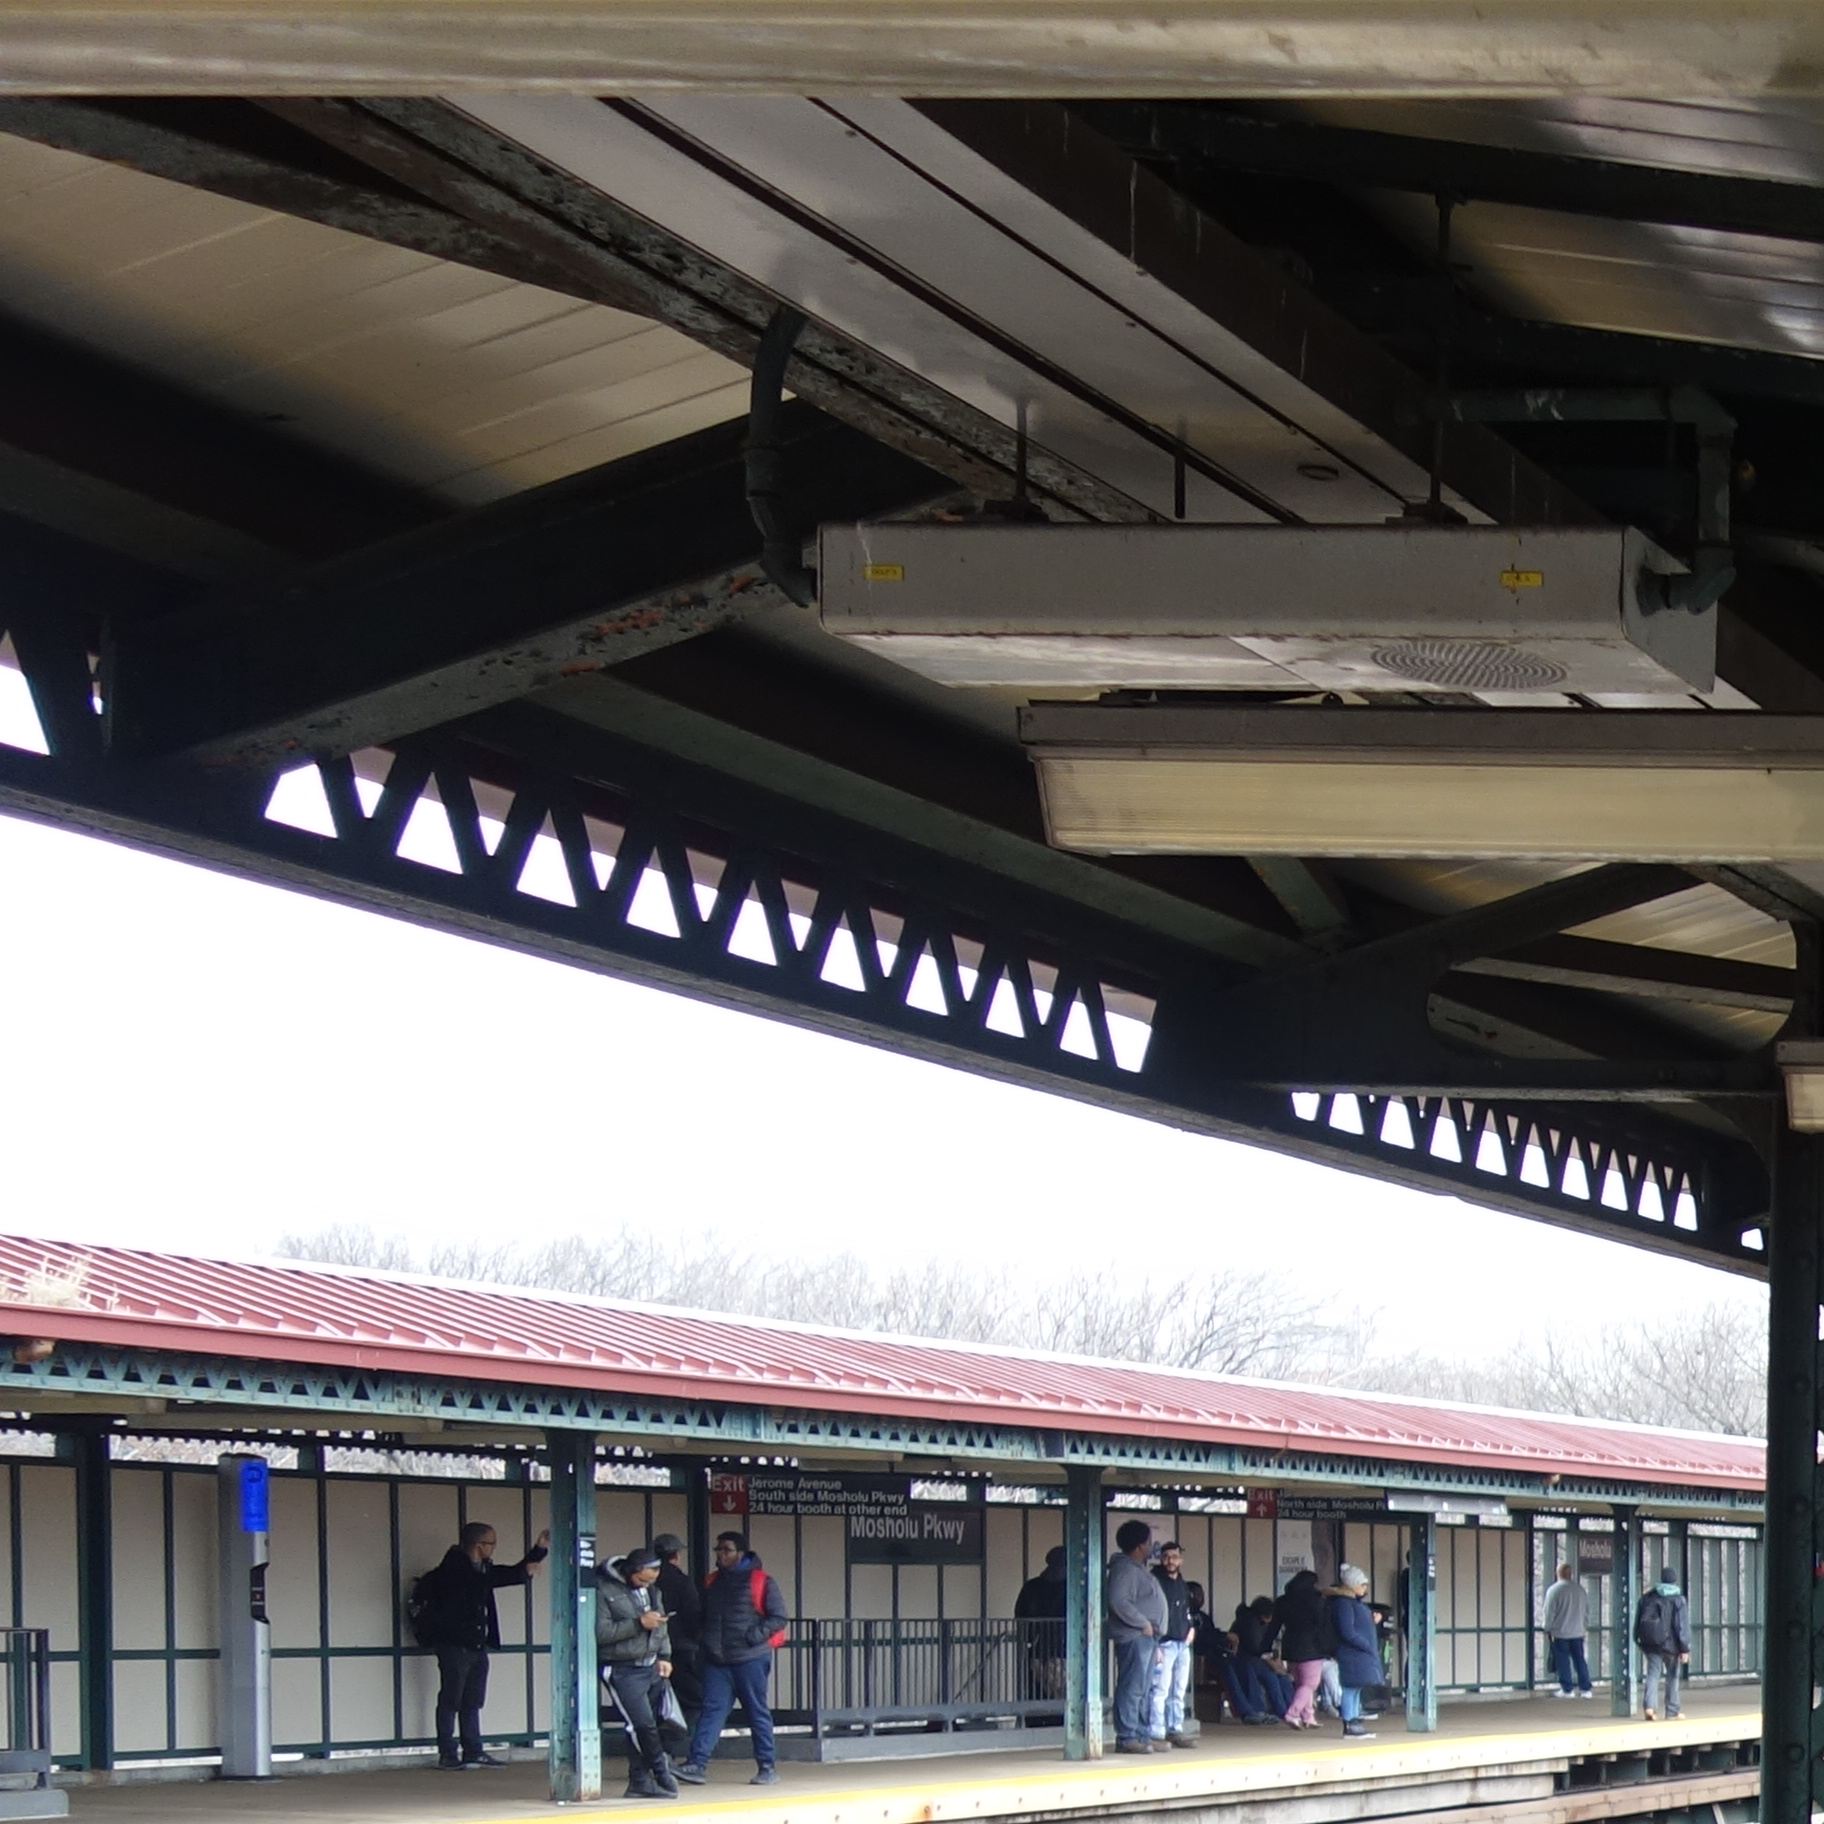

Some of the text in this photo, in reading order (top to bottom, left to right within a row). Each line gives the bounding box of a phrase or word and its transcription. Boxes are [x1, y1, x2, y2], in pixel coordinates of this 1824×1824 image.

[712, 1476, 744, 1493] Exit
[749, 1477, 842, 1489] Jerome Avenue
[749, 1489, 904, 1504] South side Mosholu Pkwy
[749, 1502, 907, 1516] 24 hour booth at other end
[850, 1513, 965, 1545] Mosholu Pkwy
